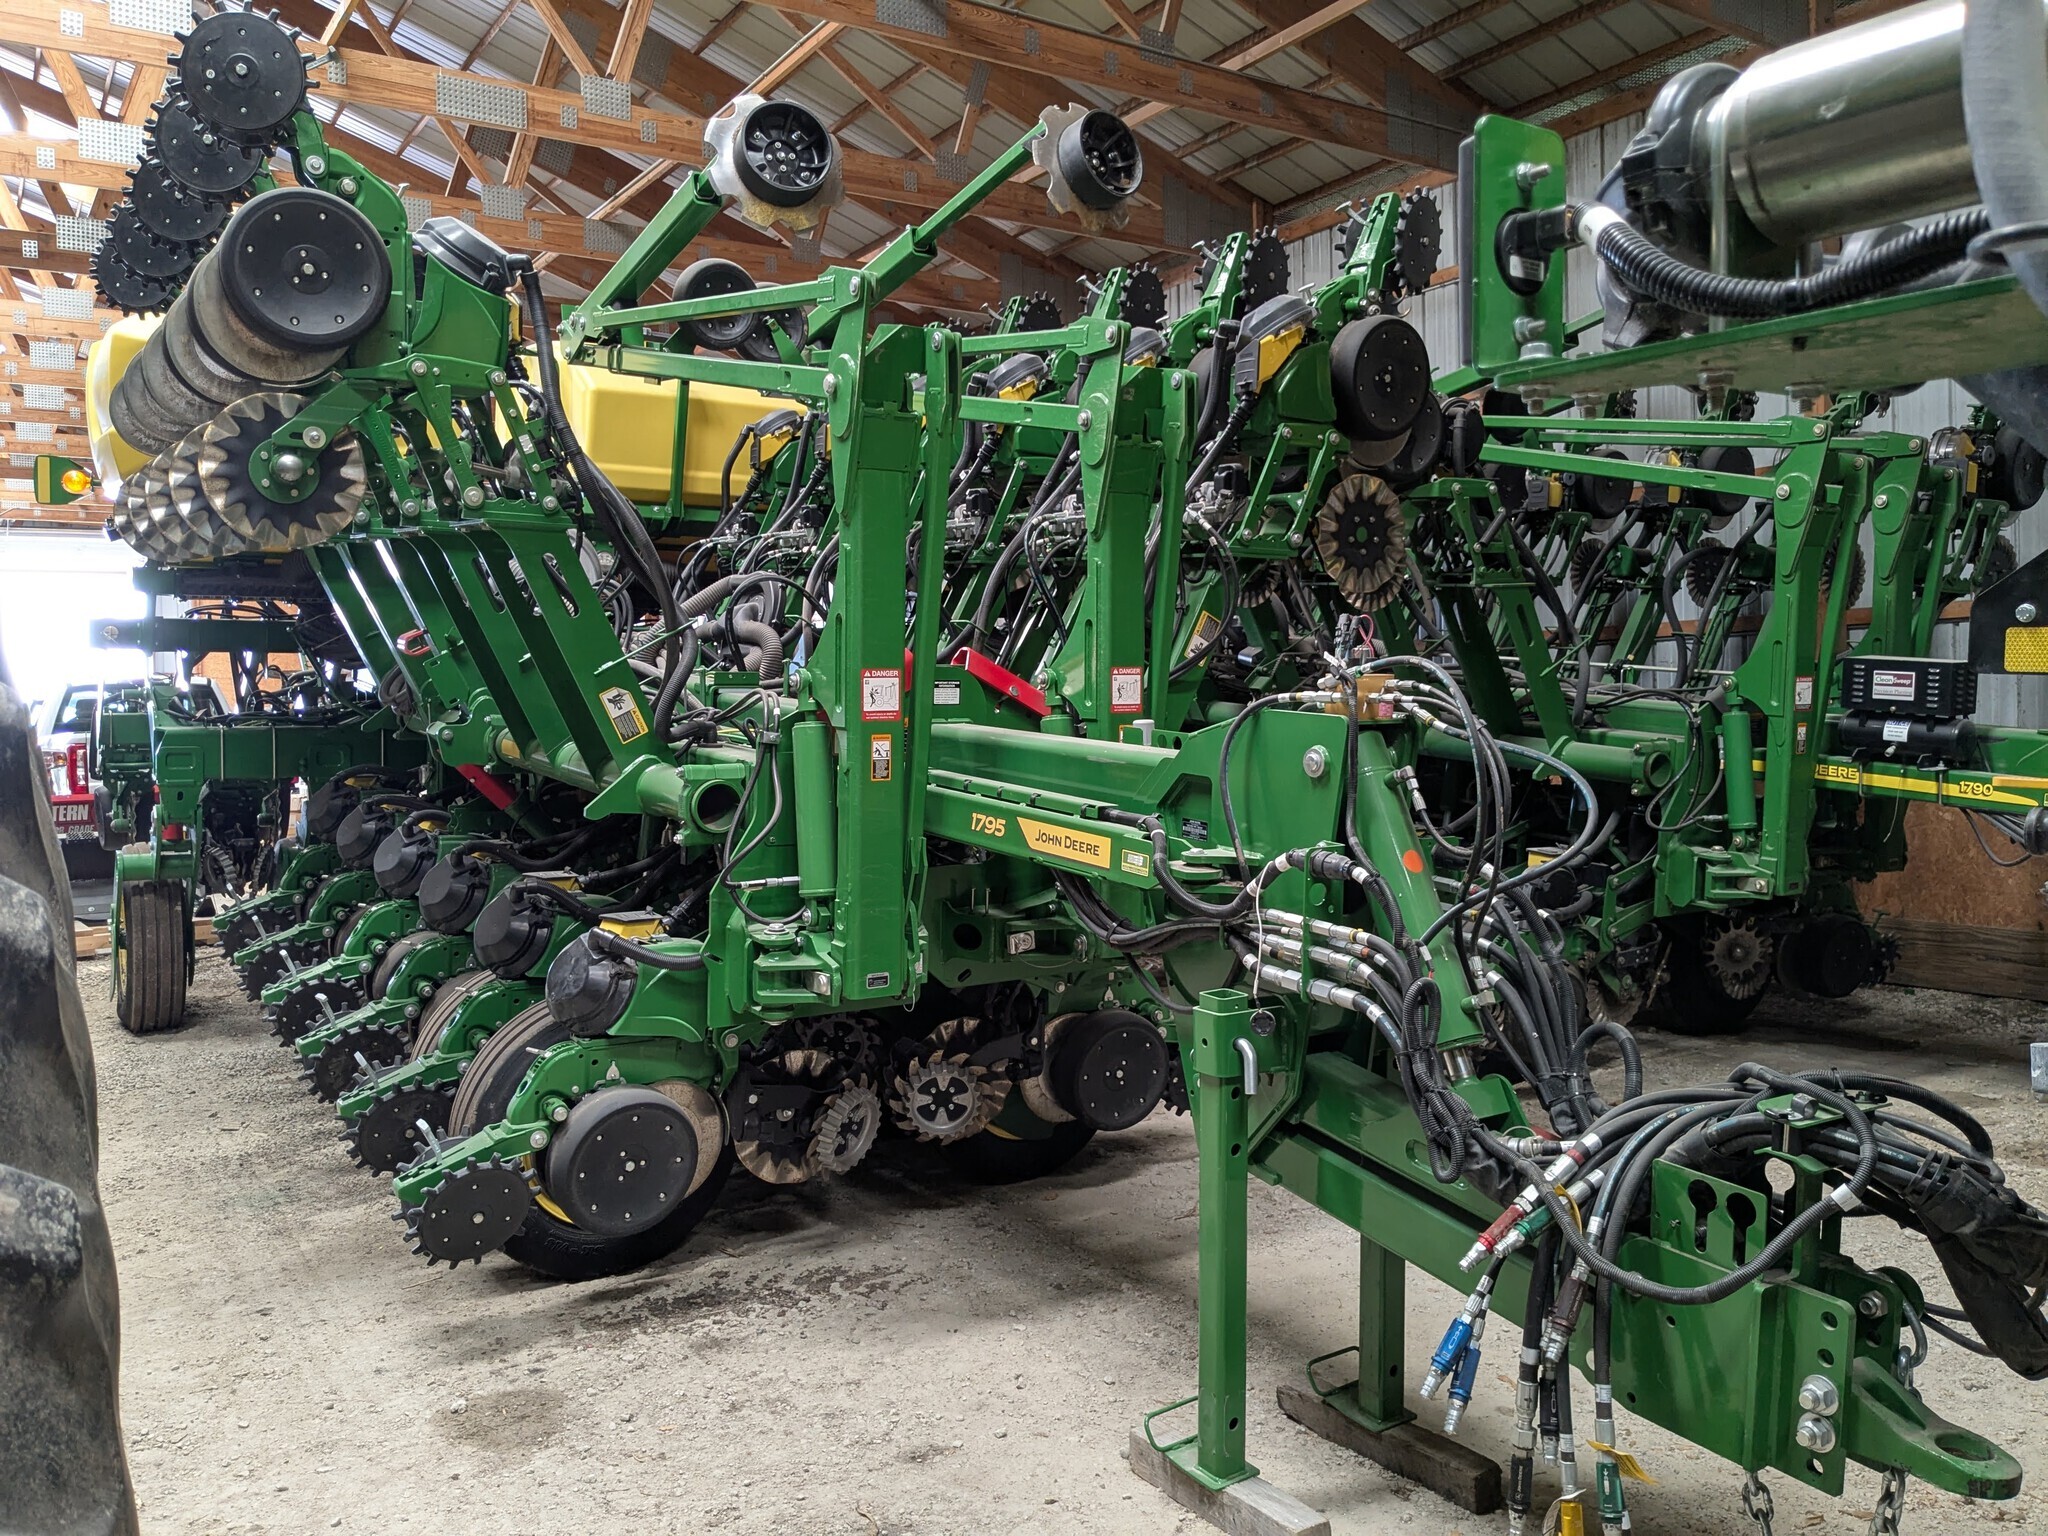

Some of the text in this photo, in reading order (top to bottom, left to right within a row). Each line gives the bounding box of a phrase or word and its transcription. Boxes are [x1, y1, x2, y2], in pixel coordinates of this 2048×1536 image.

[1959, 780, 1994, 796] 1790
[52, 804, 89, 822] TERN
[970, 812, 1007, 838] 1795
[1035, 828, 1100, 857] JOHN DEERE
